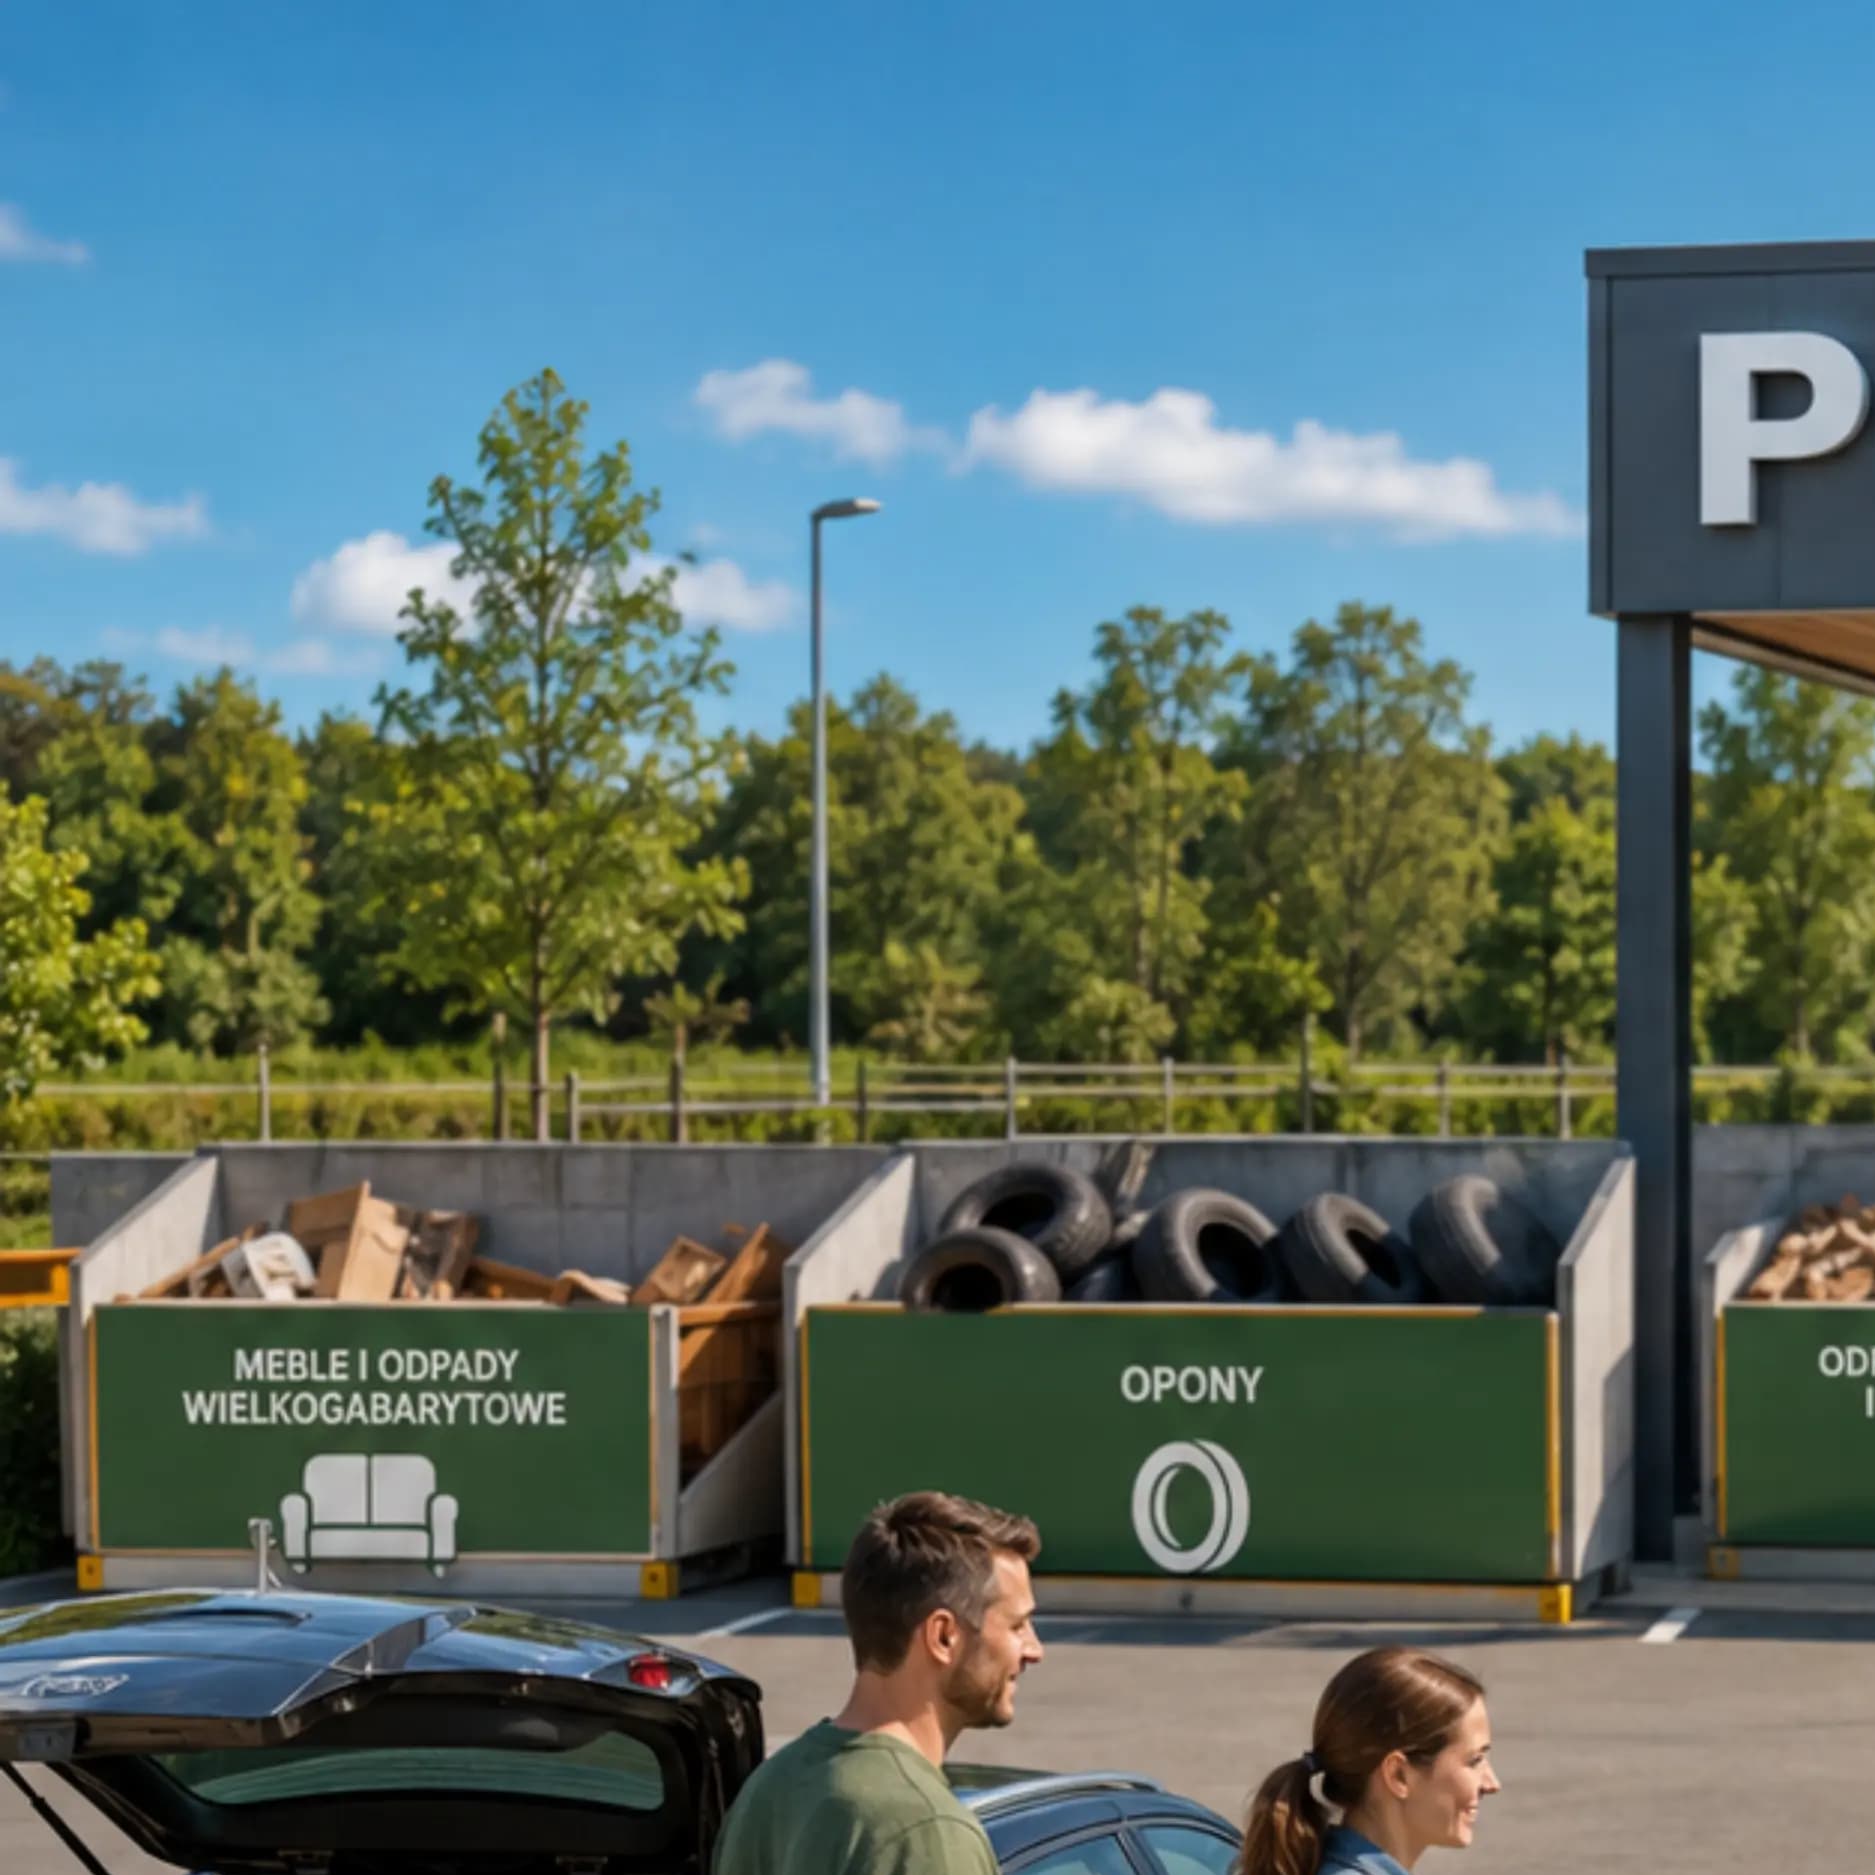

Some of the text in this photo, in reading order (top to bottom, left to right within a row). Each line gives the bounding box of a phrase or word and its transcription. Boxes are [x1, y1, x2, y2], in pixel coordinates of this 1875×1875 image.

[234, 1348, 520, 1382] MEBLE I ODPADY
[1120, 1364, 1264, 1403] OPONY
[182, 1391, 567, 1425] WIELKOGABARYTOWE
[1864, 1386, 1875, 1418] I
